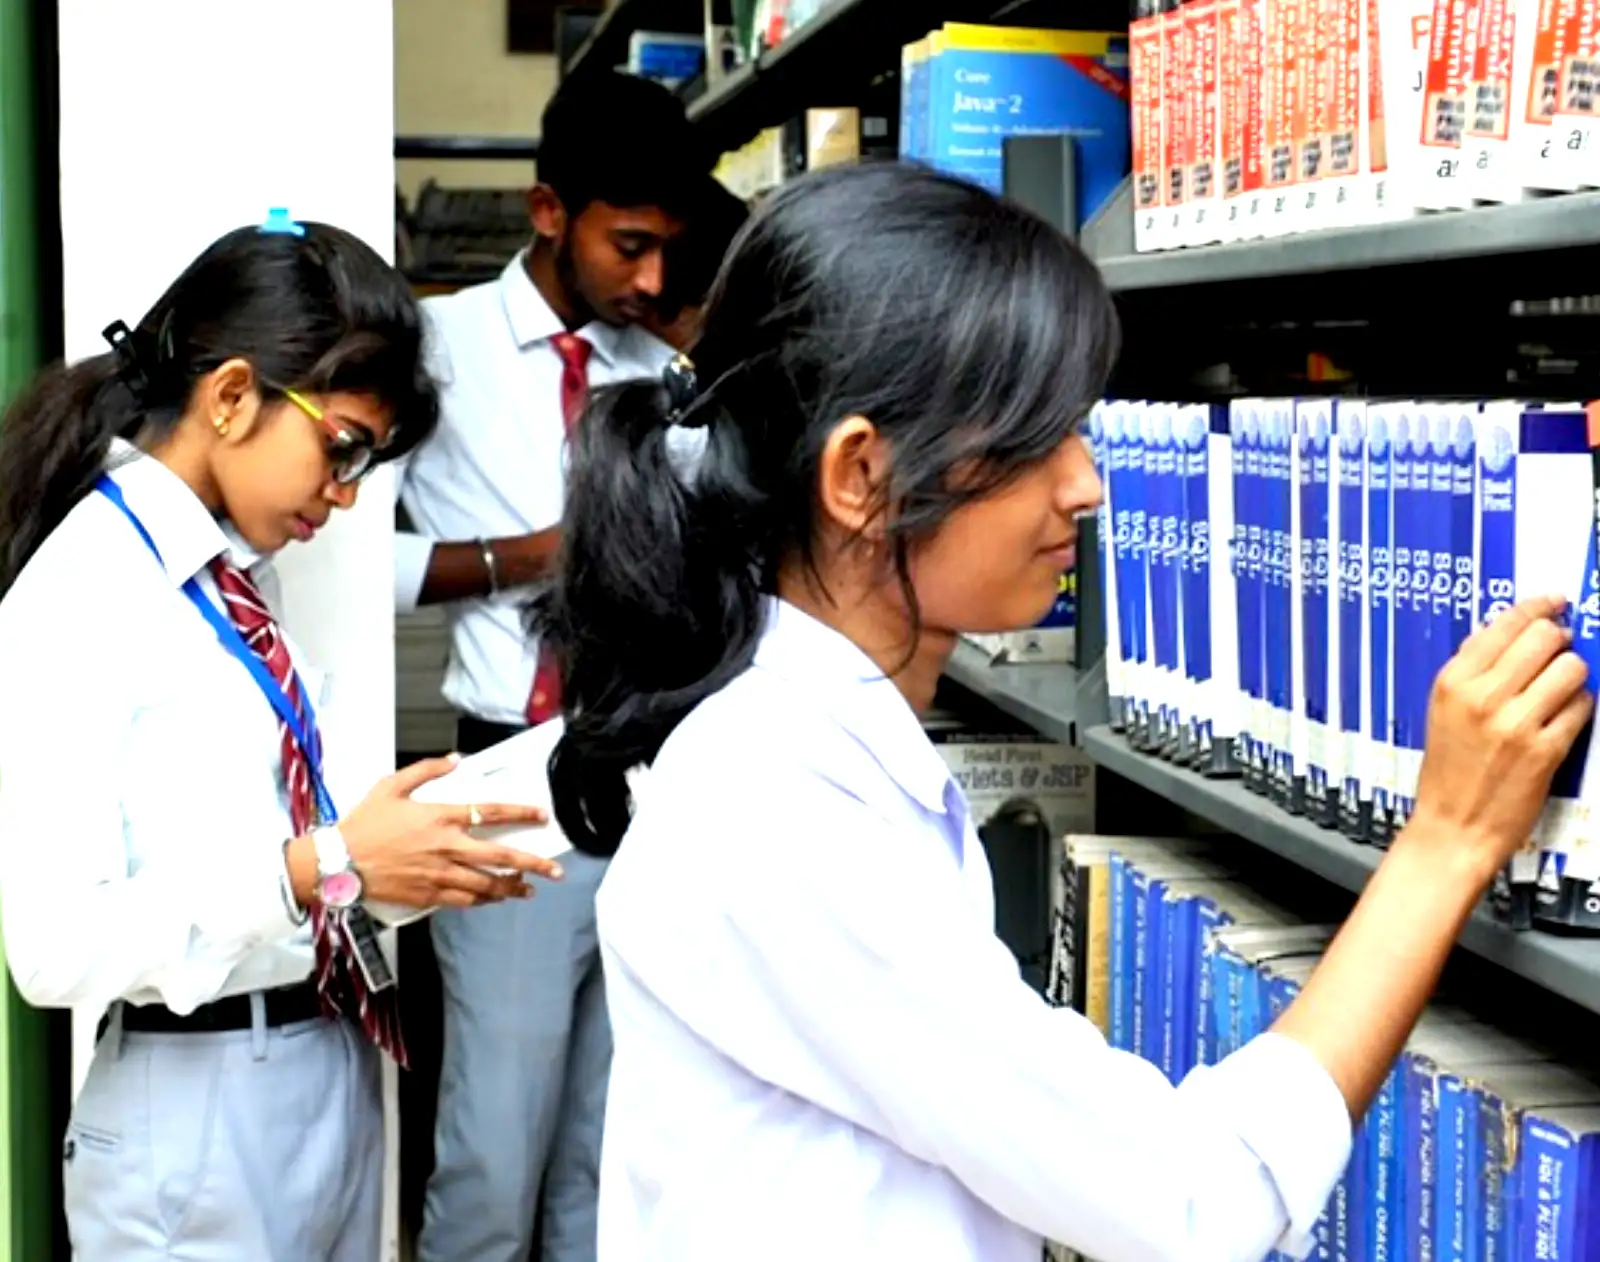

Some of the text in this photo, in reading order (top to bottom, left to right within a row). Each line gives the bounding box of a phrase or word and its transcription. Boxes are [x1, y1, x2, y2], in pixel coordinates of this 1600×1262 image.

[1370, 546, 1389, 609] SQL
[1411, 549, 1430, 612] SQL
[1431, 552, 1451, 616] SQL
[1453, 555, 1472, 621] SQL
